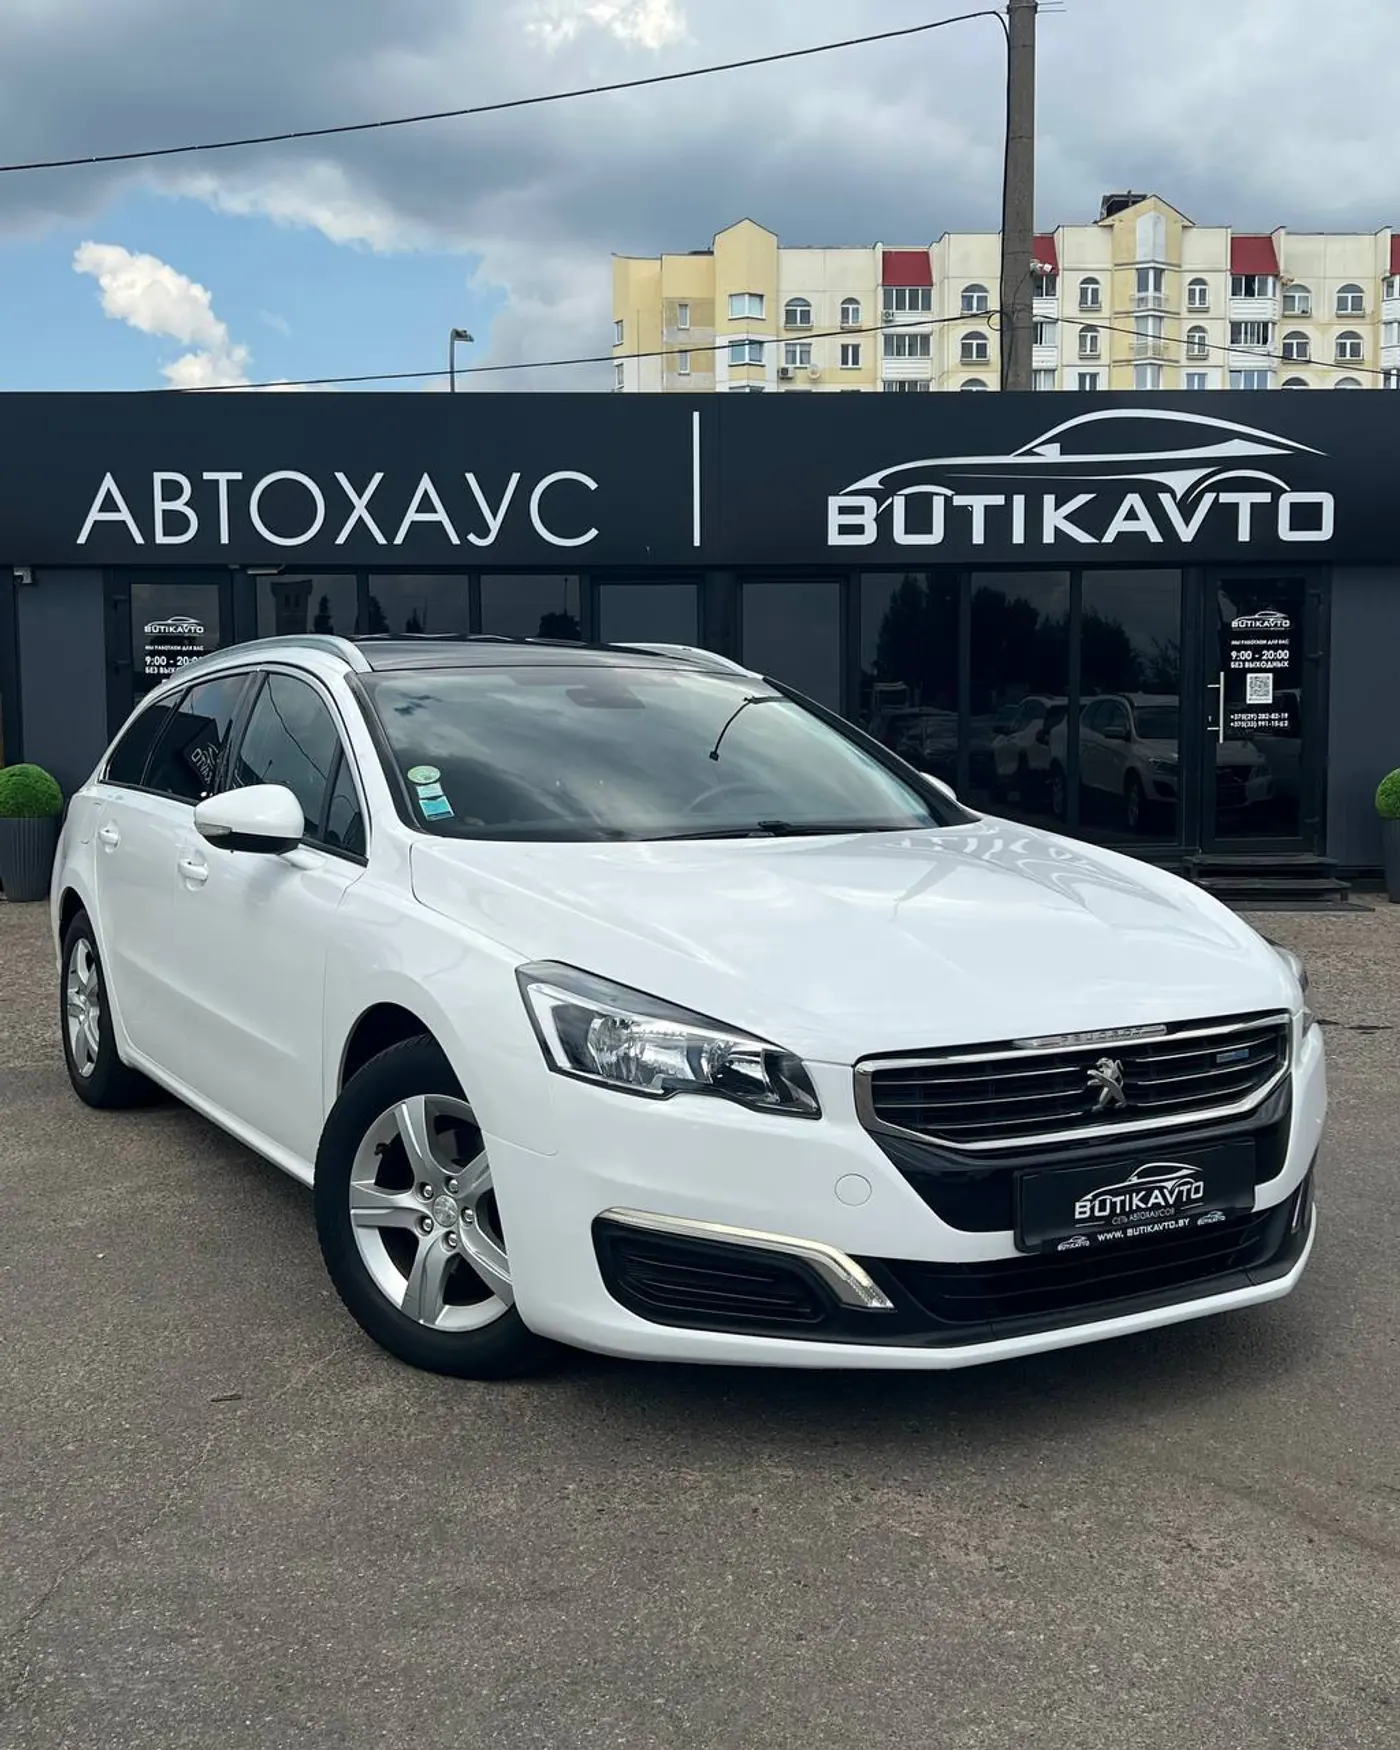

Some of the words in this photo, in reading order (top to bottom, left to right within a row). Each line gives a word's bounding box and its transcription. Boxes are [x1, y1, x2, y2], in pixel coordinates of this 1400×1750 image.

[77, 470, 600, 547] АВТОХАУС
[827, 491, 1335, 546] BUTIKAVTO
[1231, 620, 1290, 628] BUTIKAVTO
[144, 625, 204, 633] BUTIKAVTO
[1231, 651, 1252, 660] 9:00
[1261, 650, 1289, 660] 20:00
[145, 656, 167, 665] 9:00
[1230, 661, 1243, 669] БЕЗ
[1244, 661, 1289, 669] ВЫХОДНЫХ
[145, 666, 158, 674] БЕЗ
[1074, 1181, 1205, 1219] BUTIKAVTO
[1097, 1231, 1124, 1242] WWW.
[1126, 1218, 1191, 1237] BUTIKAVTO.BY
